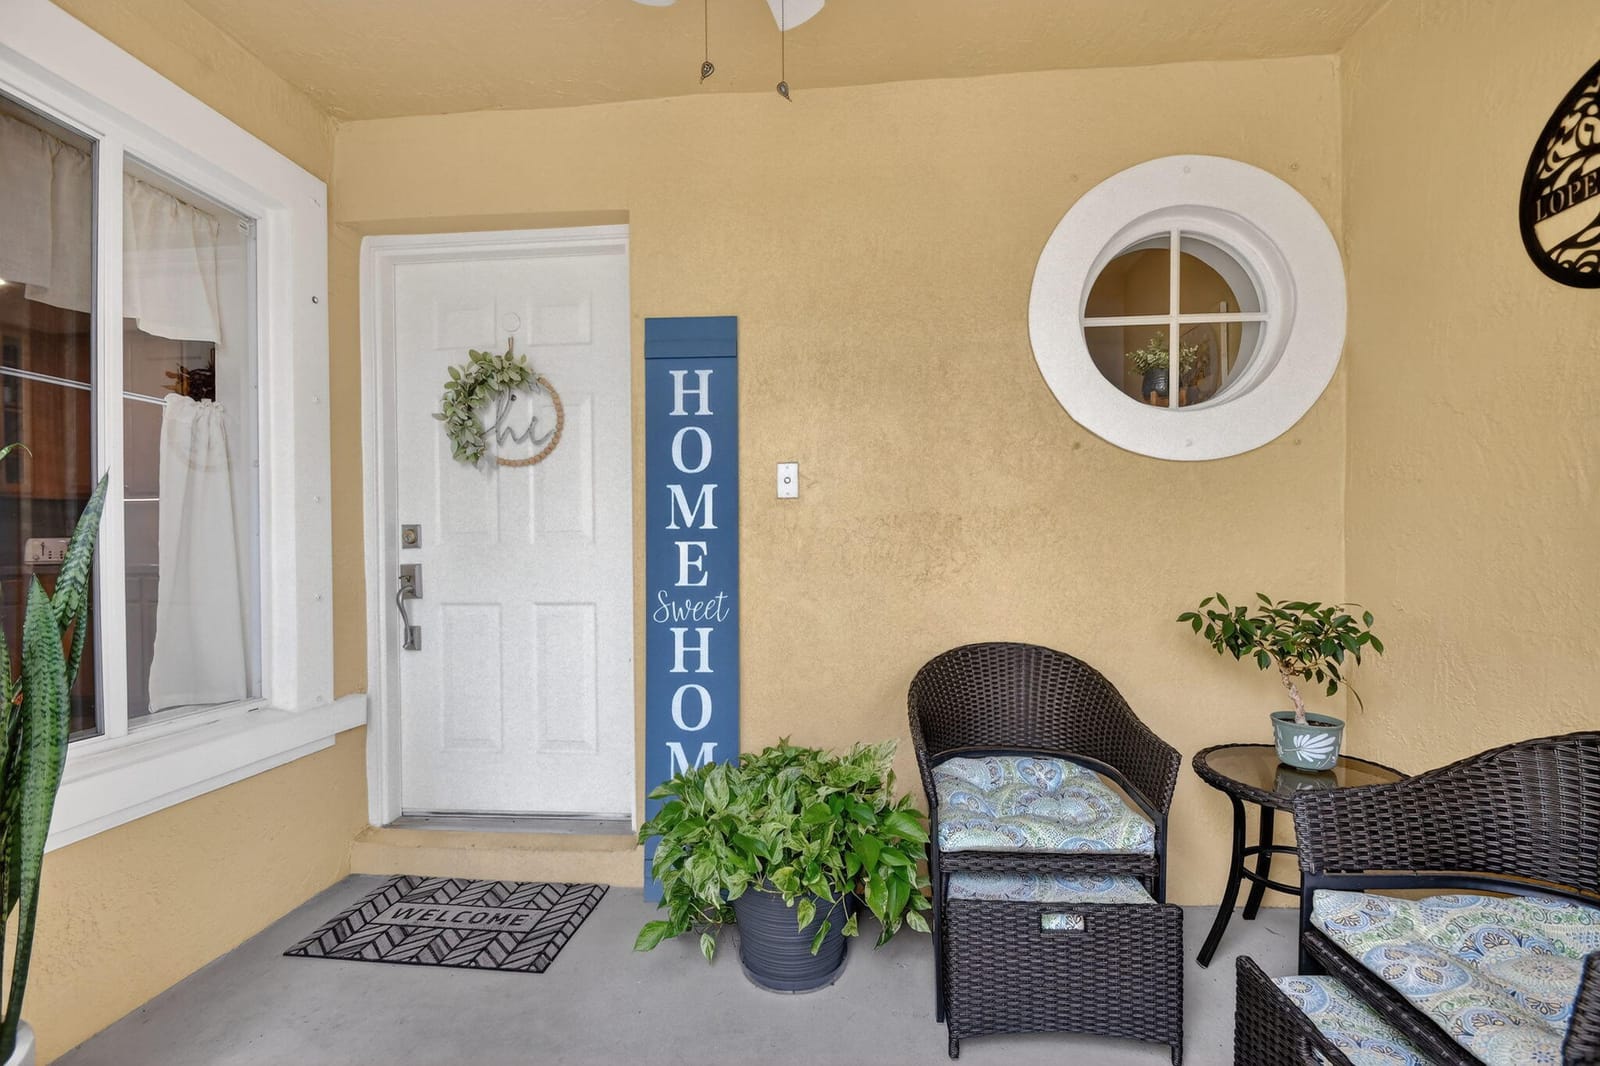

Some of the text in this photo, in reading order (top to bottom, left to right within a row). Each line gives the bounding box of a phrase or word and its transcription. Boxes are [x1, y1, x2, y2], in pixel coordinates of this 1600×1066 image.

[1536, 171, 1598, 222] LOPE
[480, 384, 556, 446] hi
[665, 369, 718, 587] HOME
[653, 589, 730, 623] Sweet
[391, 907, 530, 926] WELCOME
